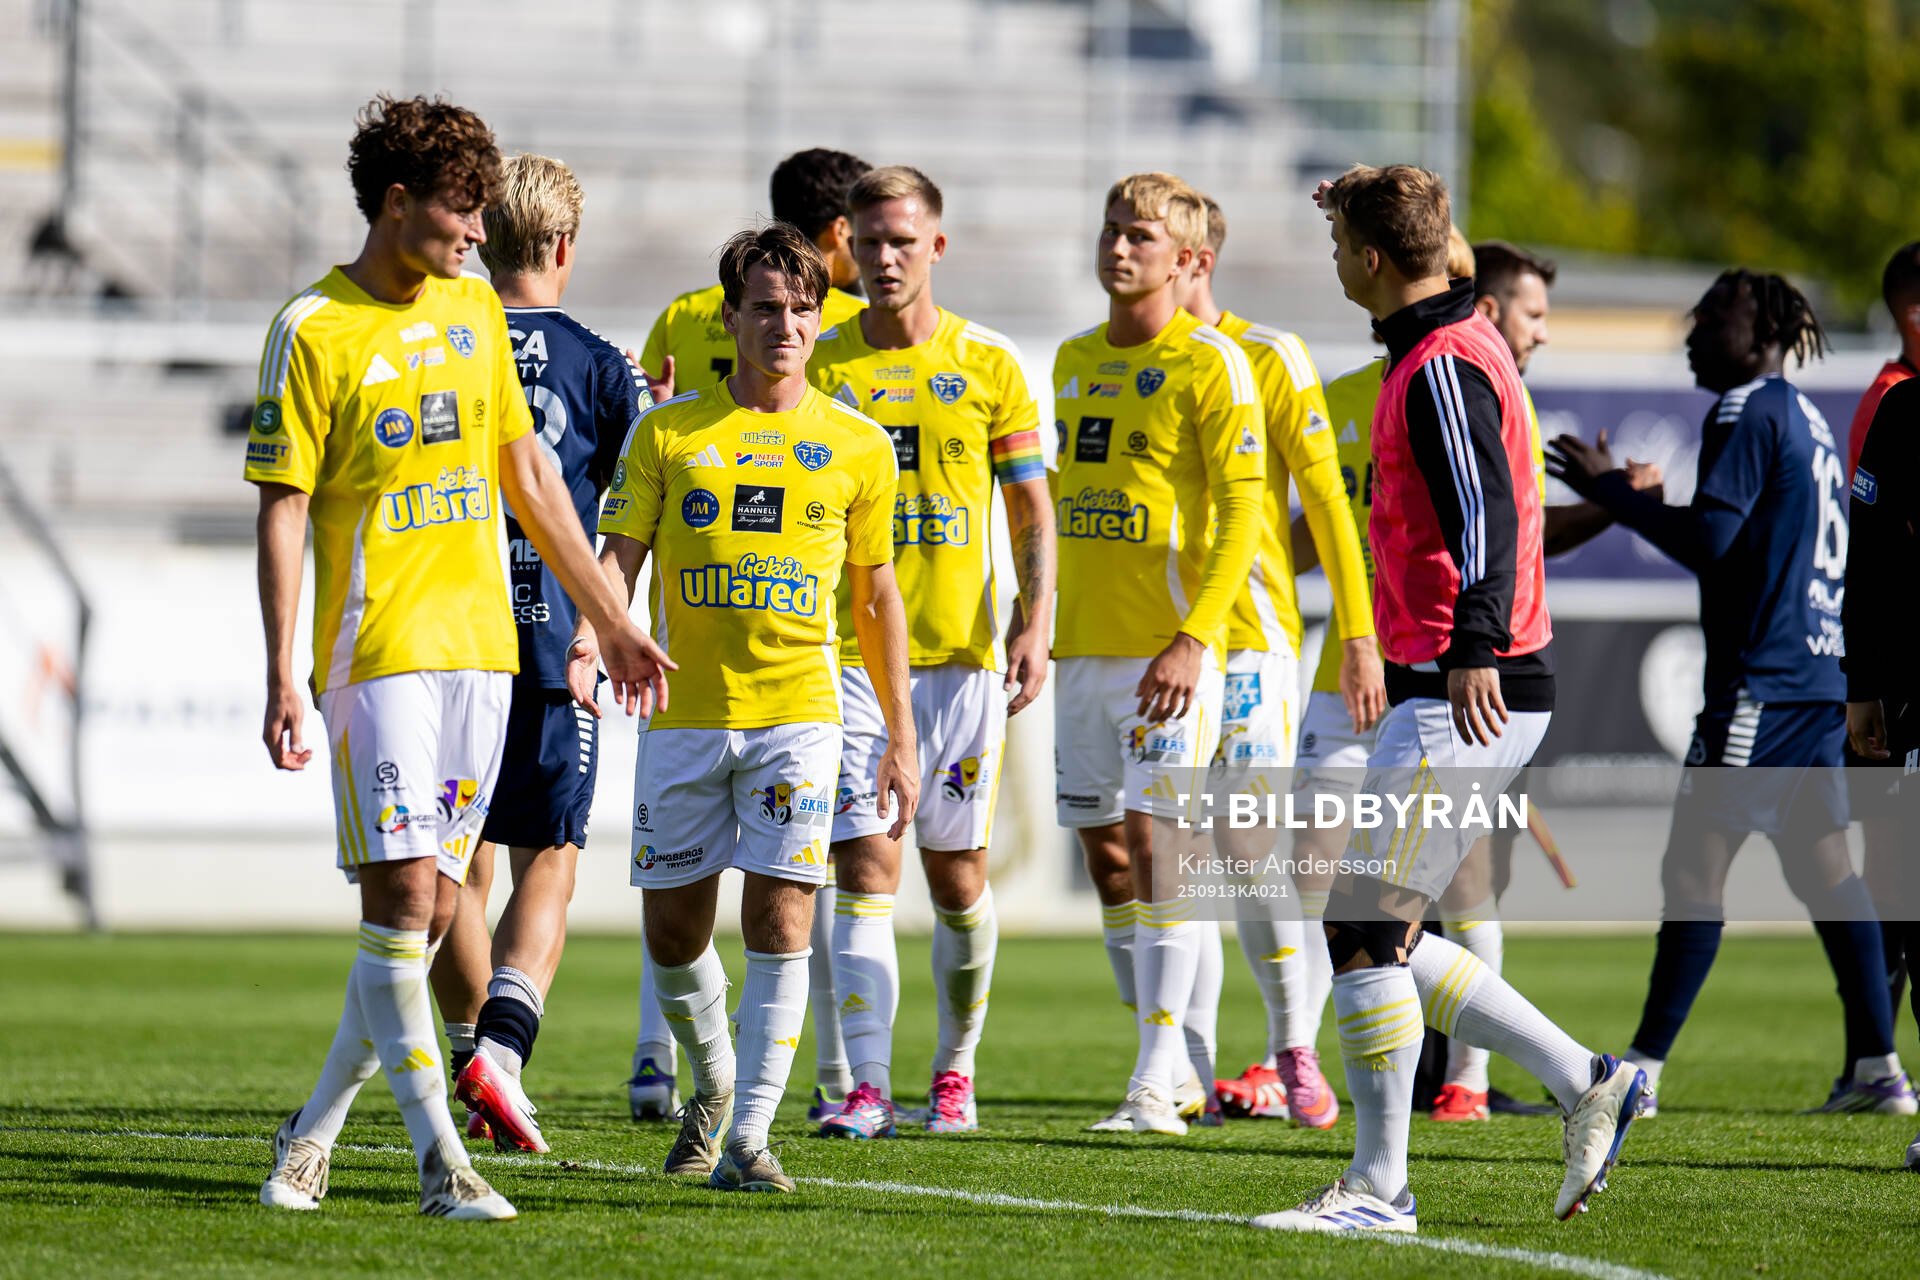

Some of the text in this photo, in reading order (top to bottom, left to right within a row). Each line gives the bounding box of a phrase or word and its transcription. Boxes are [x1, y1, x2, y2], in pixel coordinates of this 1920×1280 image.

[740, 431, 786, 446] Ullared
[248, 442, 289, 457] NIBET
[754, 453, 785, 461] INTER
[753, 460, 783, 469] SPORT
[1854, 472, 1875, 493] IBET
[604, 498, 628, 510] IBET
[690, 502, 709, 516] JM
[737, 506, 777, 515] HANNELL
[1811, 444, 1850, 581] 16
[892, 506, 969, 546] ared
[737, 552, 803, 583] Gekås
[680, 564, 818, 617] Ullared
[799, 797, 829, 814] SKAB
[645, 847, 704, 863] LJUNGBERGS
